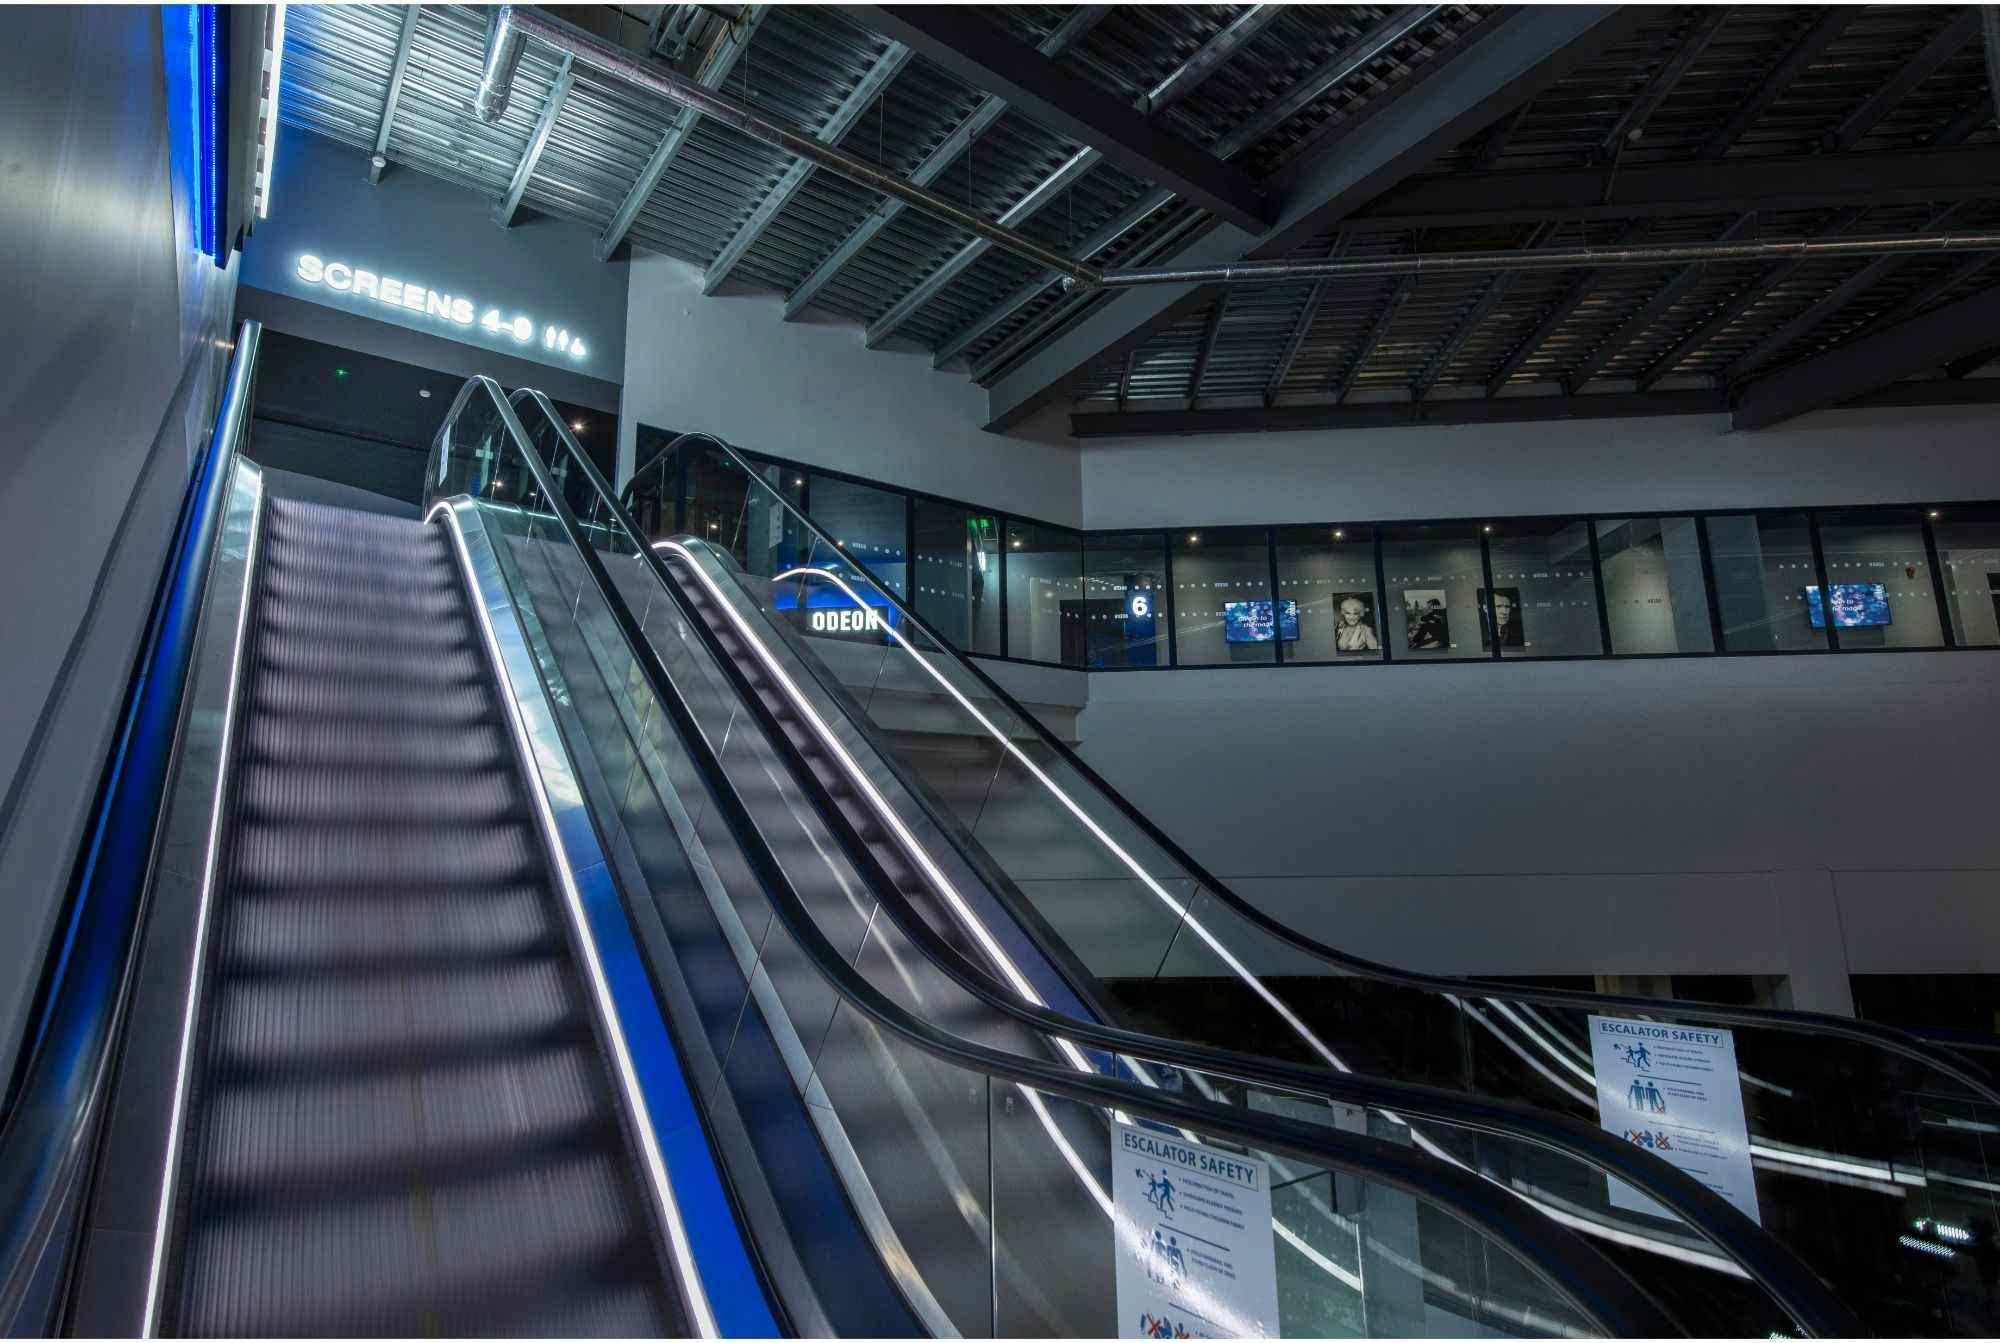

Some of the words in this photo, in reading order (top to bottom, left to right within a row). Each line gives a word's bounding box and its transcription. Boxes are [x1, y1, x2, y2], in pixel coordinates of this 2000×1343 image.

[297, 254, 474, 325] SCREENS
[1132, 596, 1148, 616] 6
[812, 608, 879, 631] ODEON
[1601, 1022, 1669, 1039] ESCALATOR
[1672, 1030, 1718, 1044] SAFETY
[1124, 1132, 1196, 1167] ESCALATOR
[1200, 1155, 1253, 1184] SAFETY
